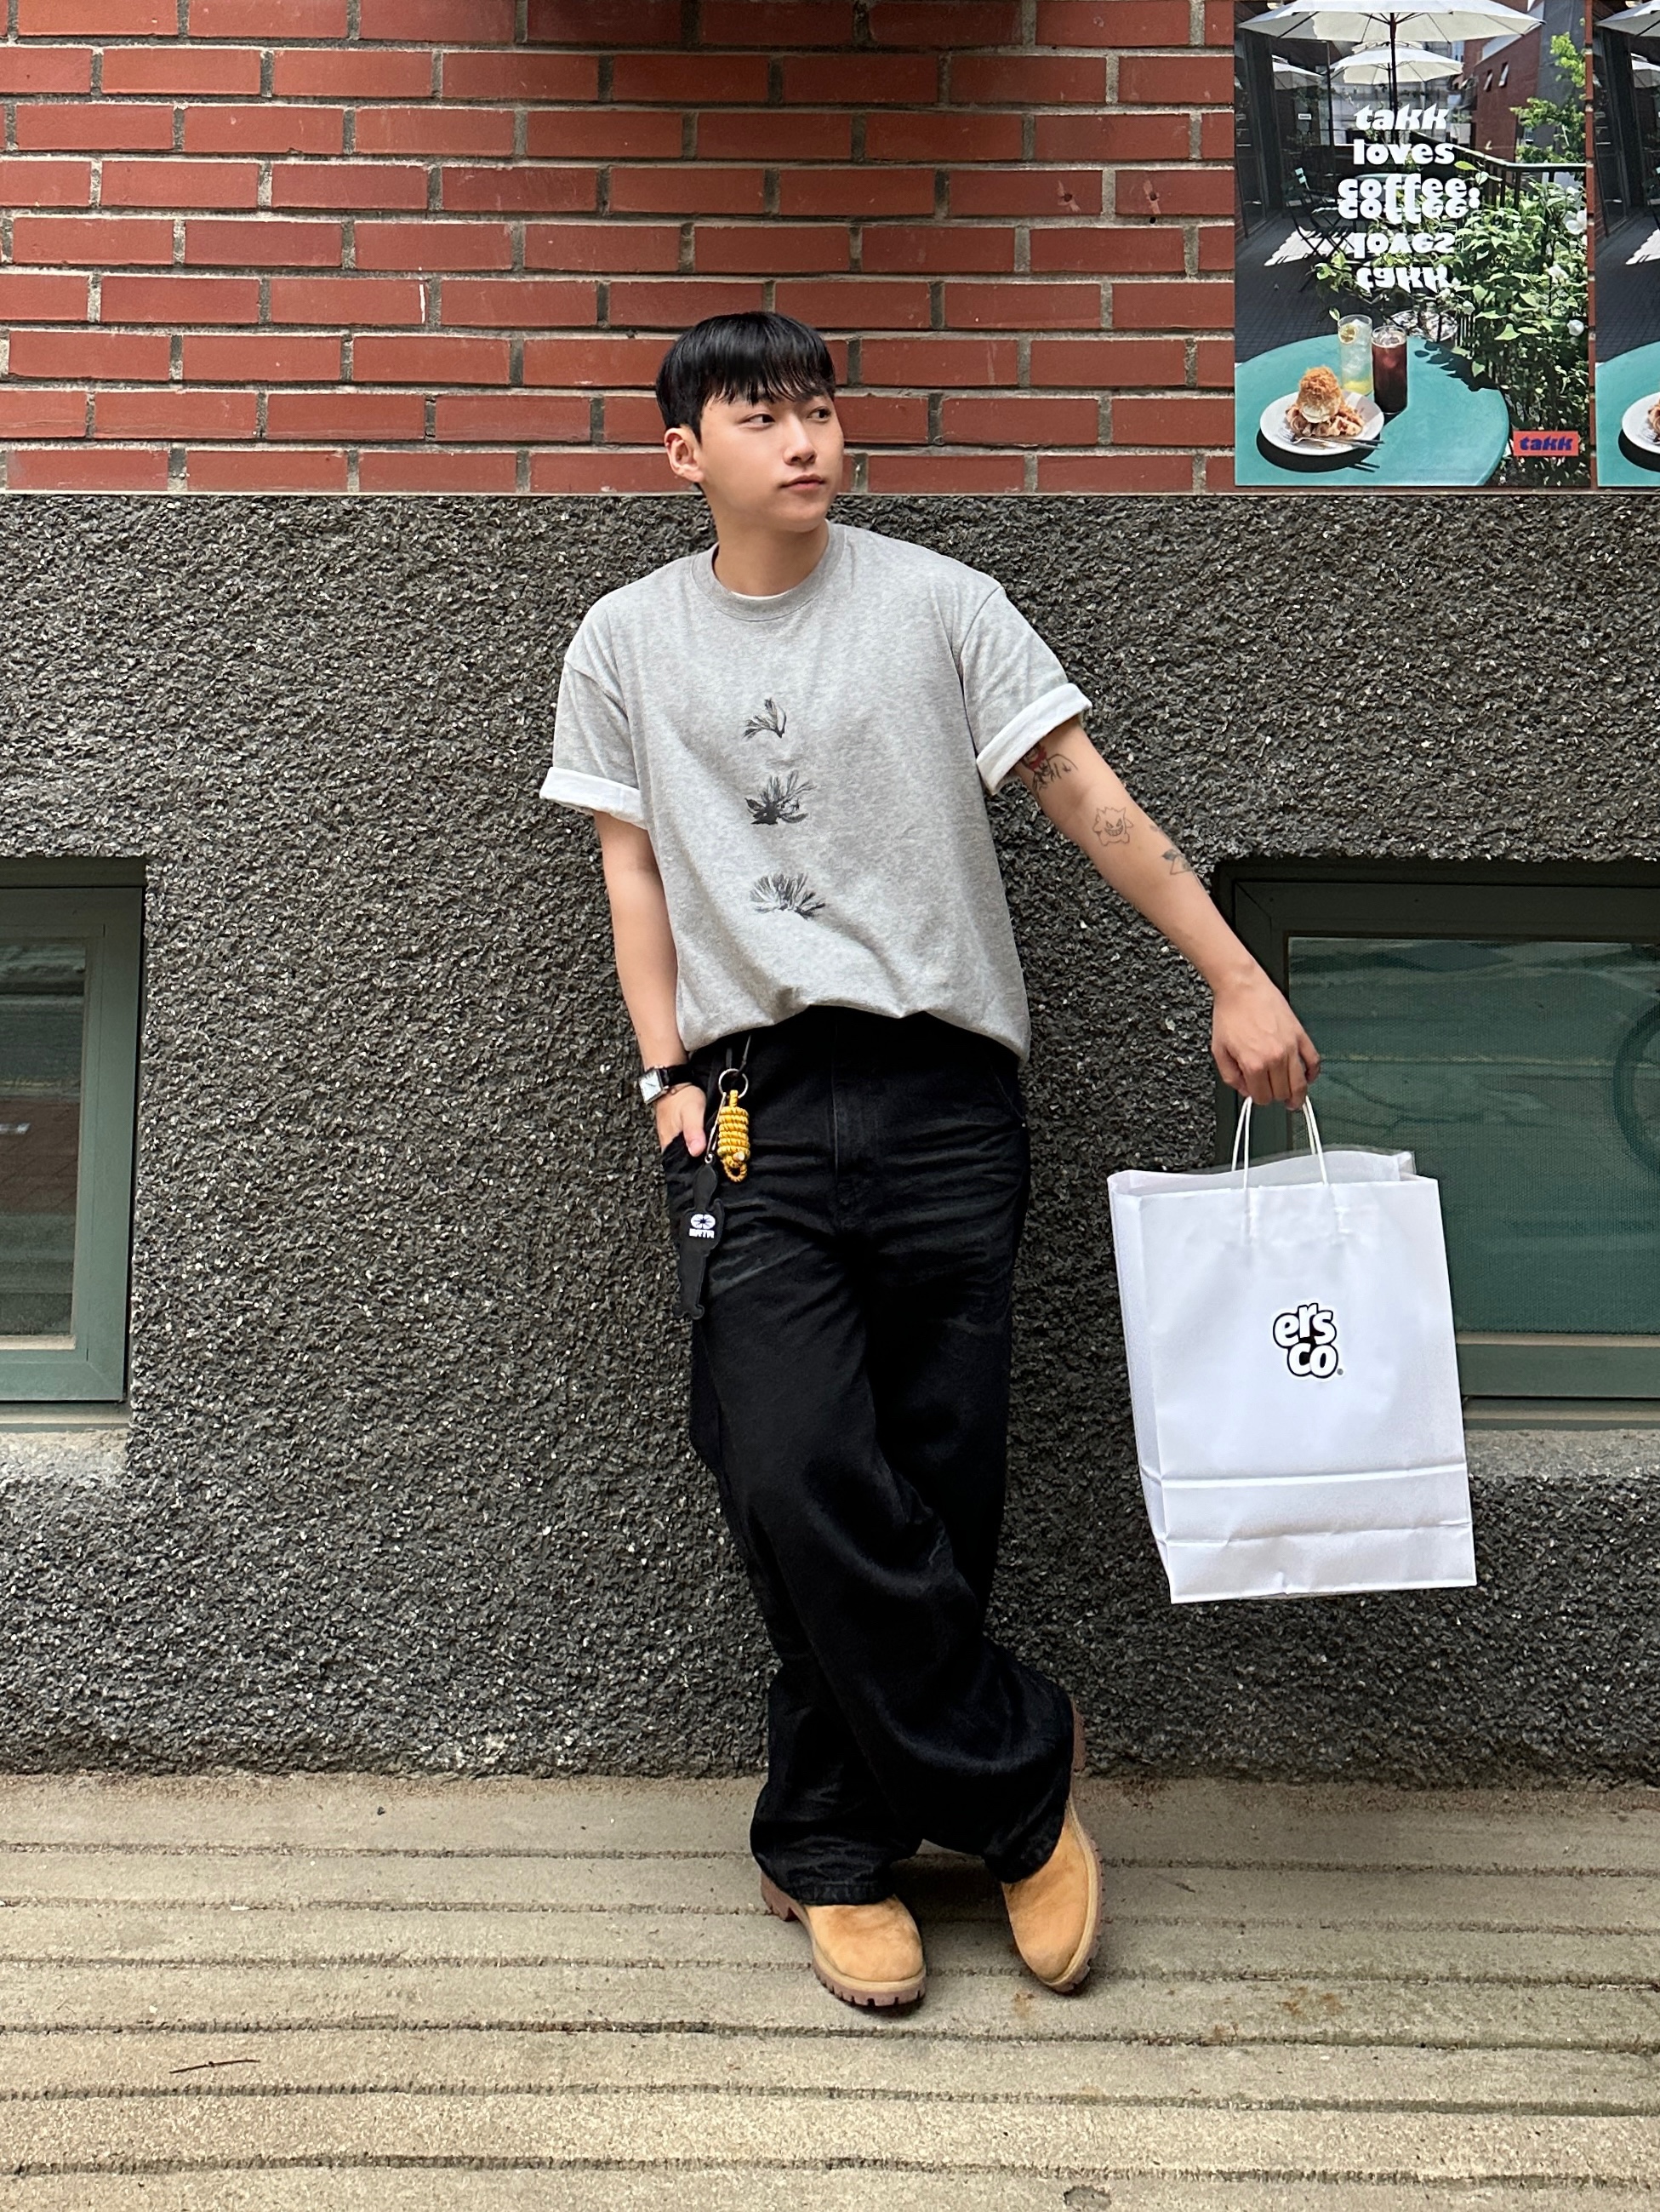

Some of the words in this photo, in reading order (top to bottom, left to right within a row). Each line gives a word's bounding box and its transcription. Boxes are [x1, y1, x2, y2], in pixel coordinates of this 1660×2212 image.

[1354, 103, 1450, 130] takk
[1353, 139, 1455, 165] loves
[1520, 435, 1573, 451] takk
[1273, 1302, 1337, 1349] ers
